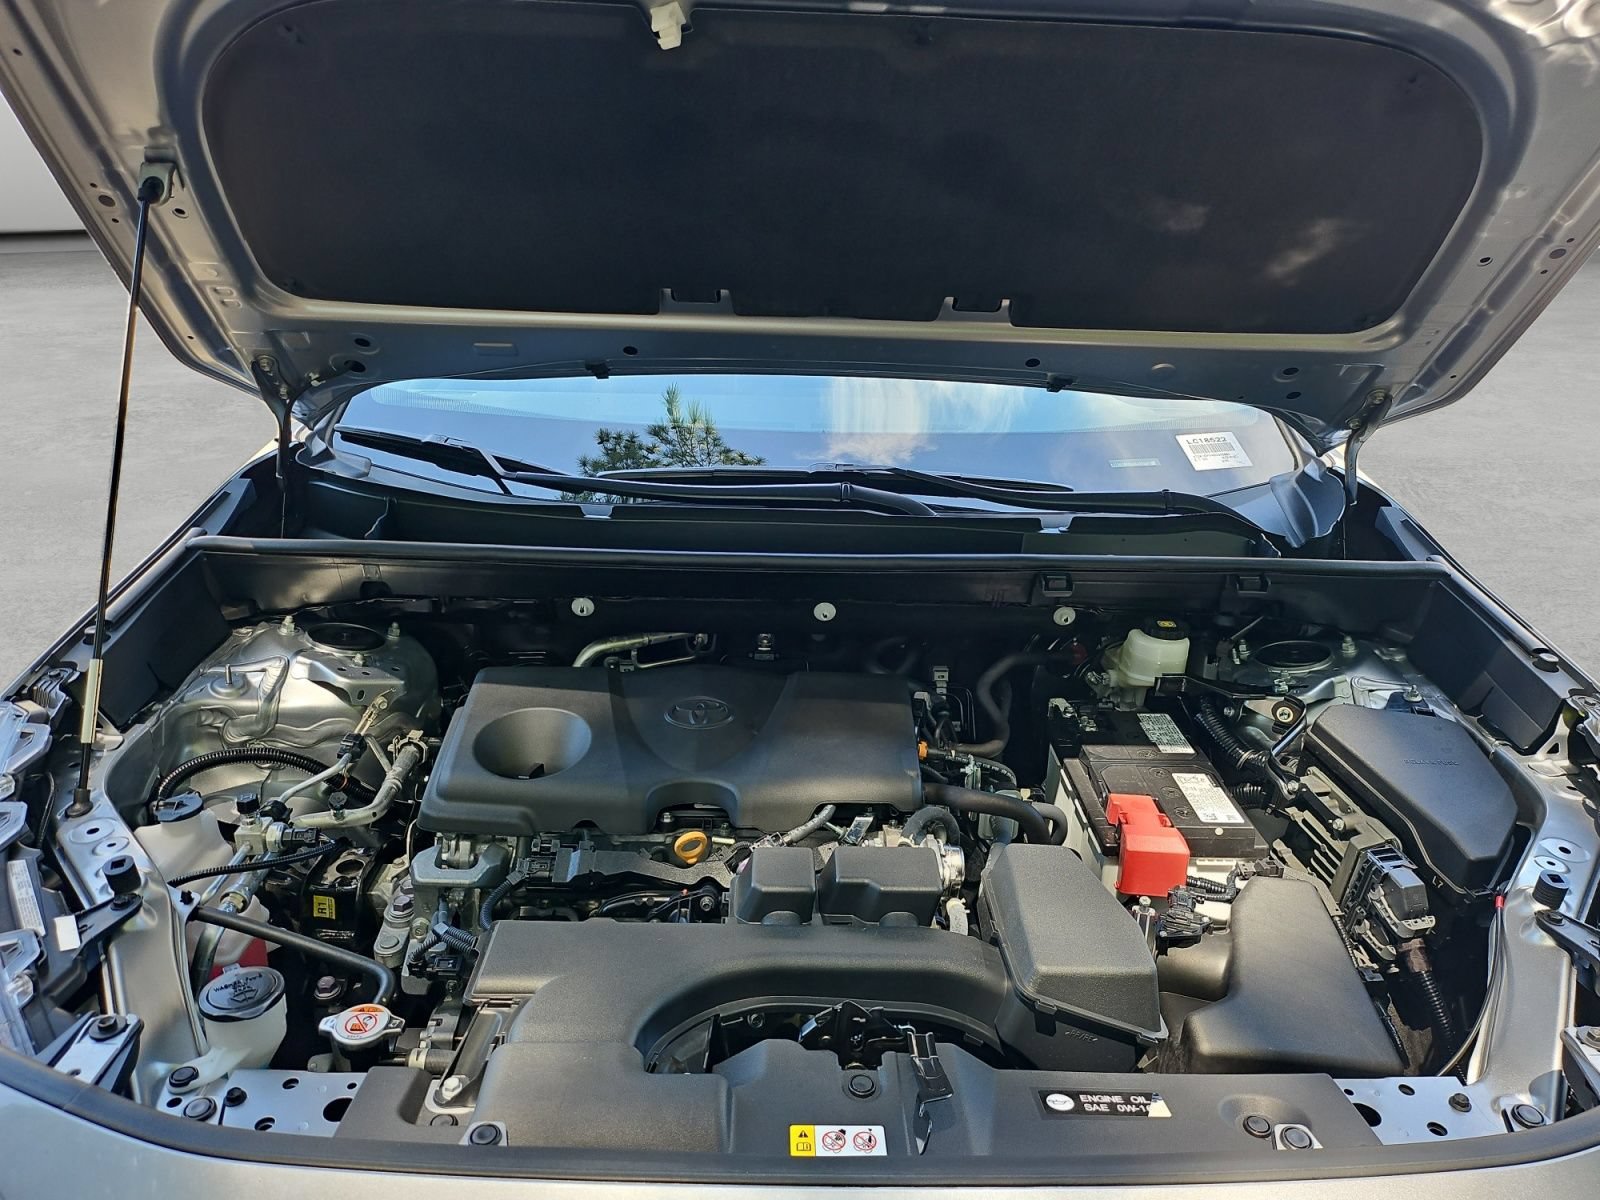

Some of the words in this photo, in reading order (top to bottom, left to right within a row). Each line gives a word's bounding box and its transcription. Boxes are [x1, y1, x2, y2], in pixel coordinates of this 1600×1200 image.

[1079, 1094, 1125, 1103] ENGINE
[1130, 1095, 1152, 1104] OIL
[1083, 1103, 1110, 1112] SAE
